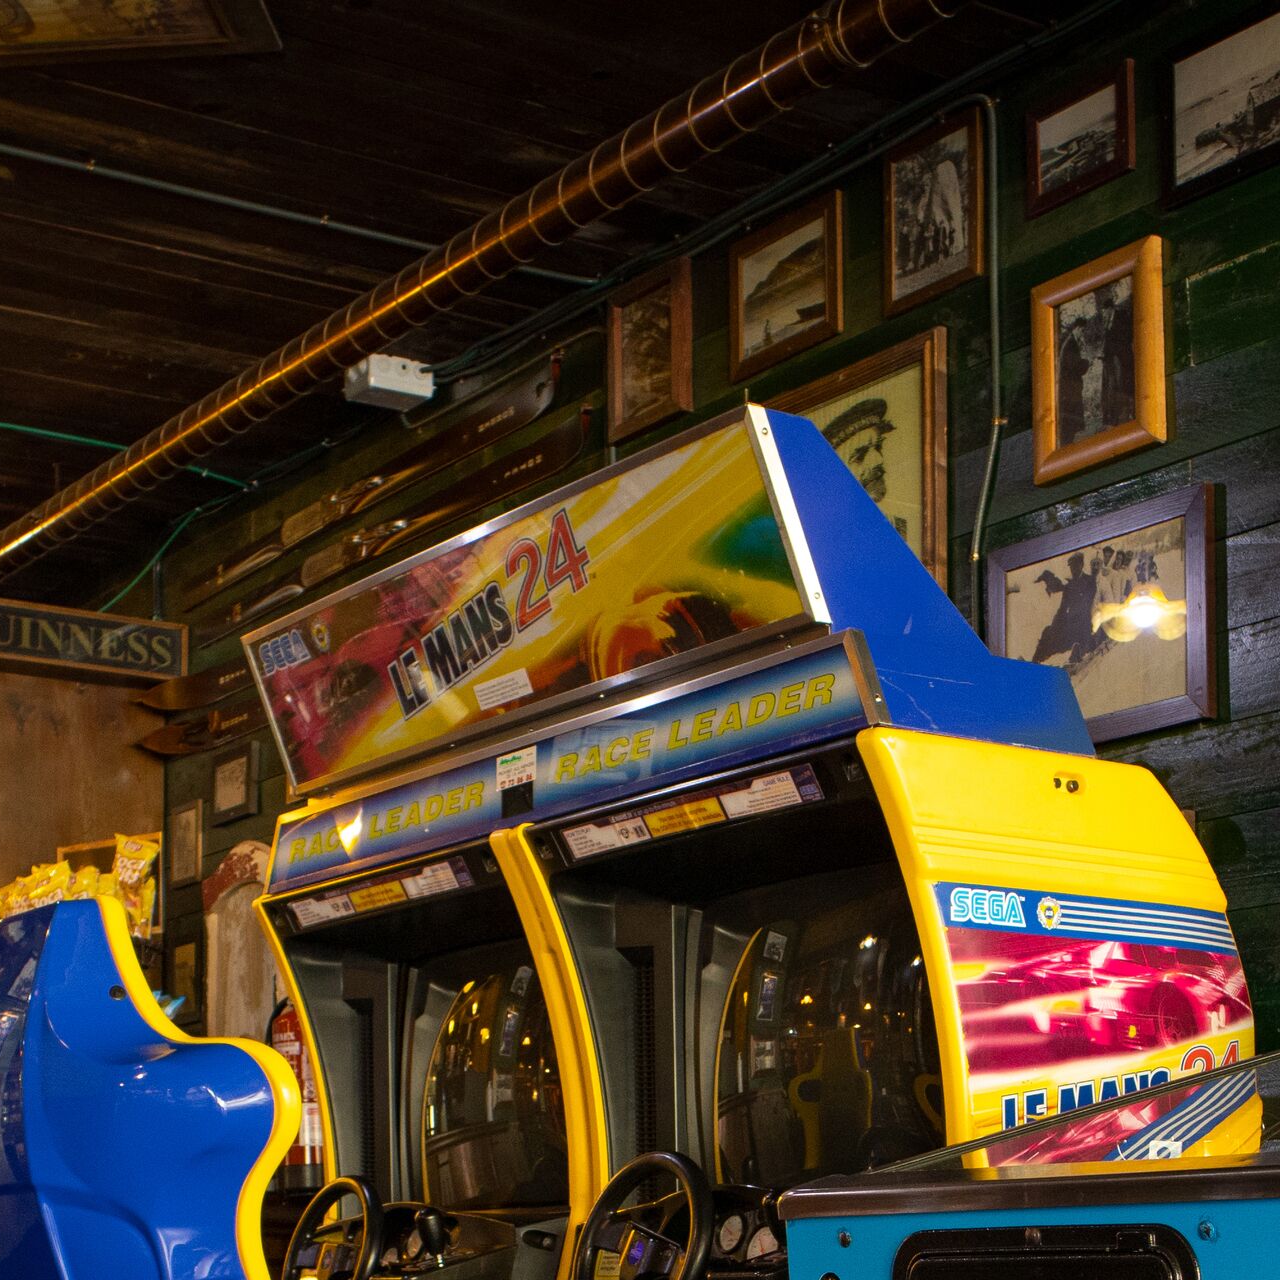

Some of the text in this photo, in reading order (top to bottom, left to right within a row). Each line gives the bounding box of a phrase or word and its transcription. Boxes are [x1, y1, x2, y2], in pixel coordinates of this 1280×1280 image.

[387, 508, 591, 720] LE MANS 24
[259, 628, 312, 677] SEGA
[555, 728, 654, 784] RACE
[667, 672, 838, 751] LEADER
[288, 780, 484, 864] RAC LEADER
[950, 887, 1025, 928] SEGA
[1001, 1088, 1048, 1131] LE
